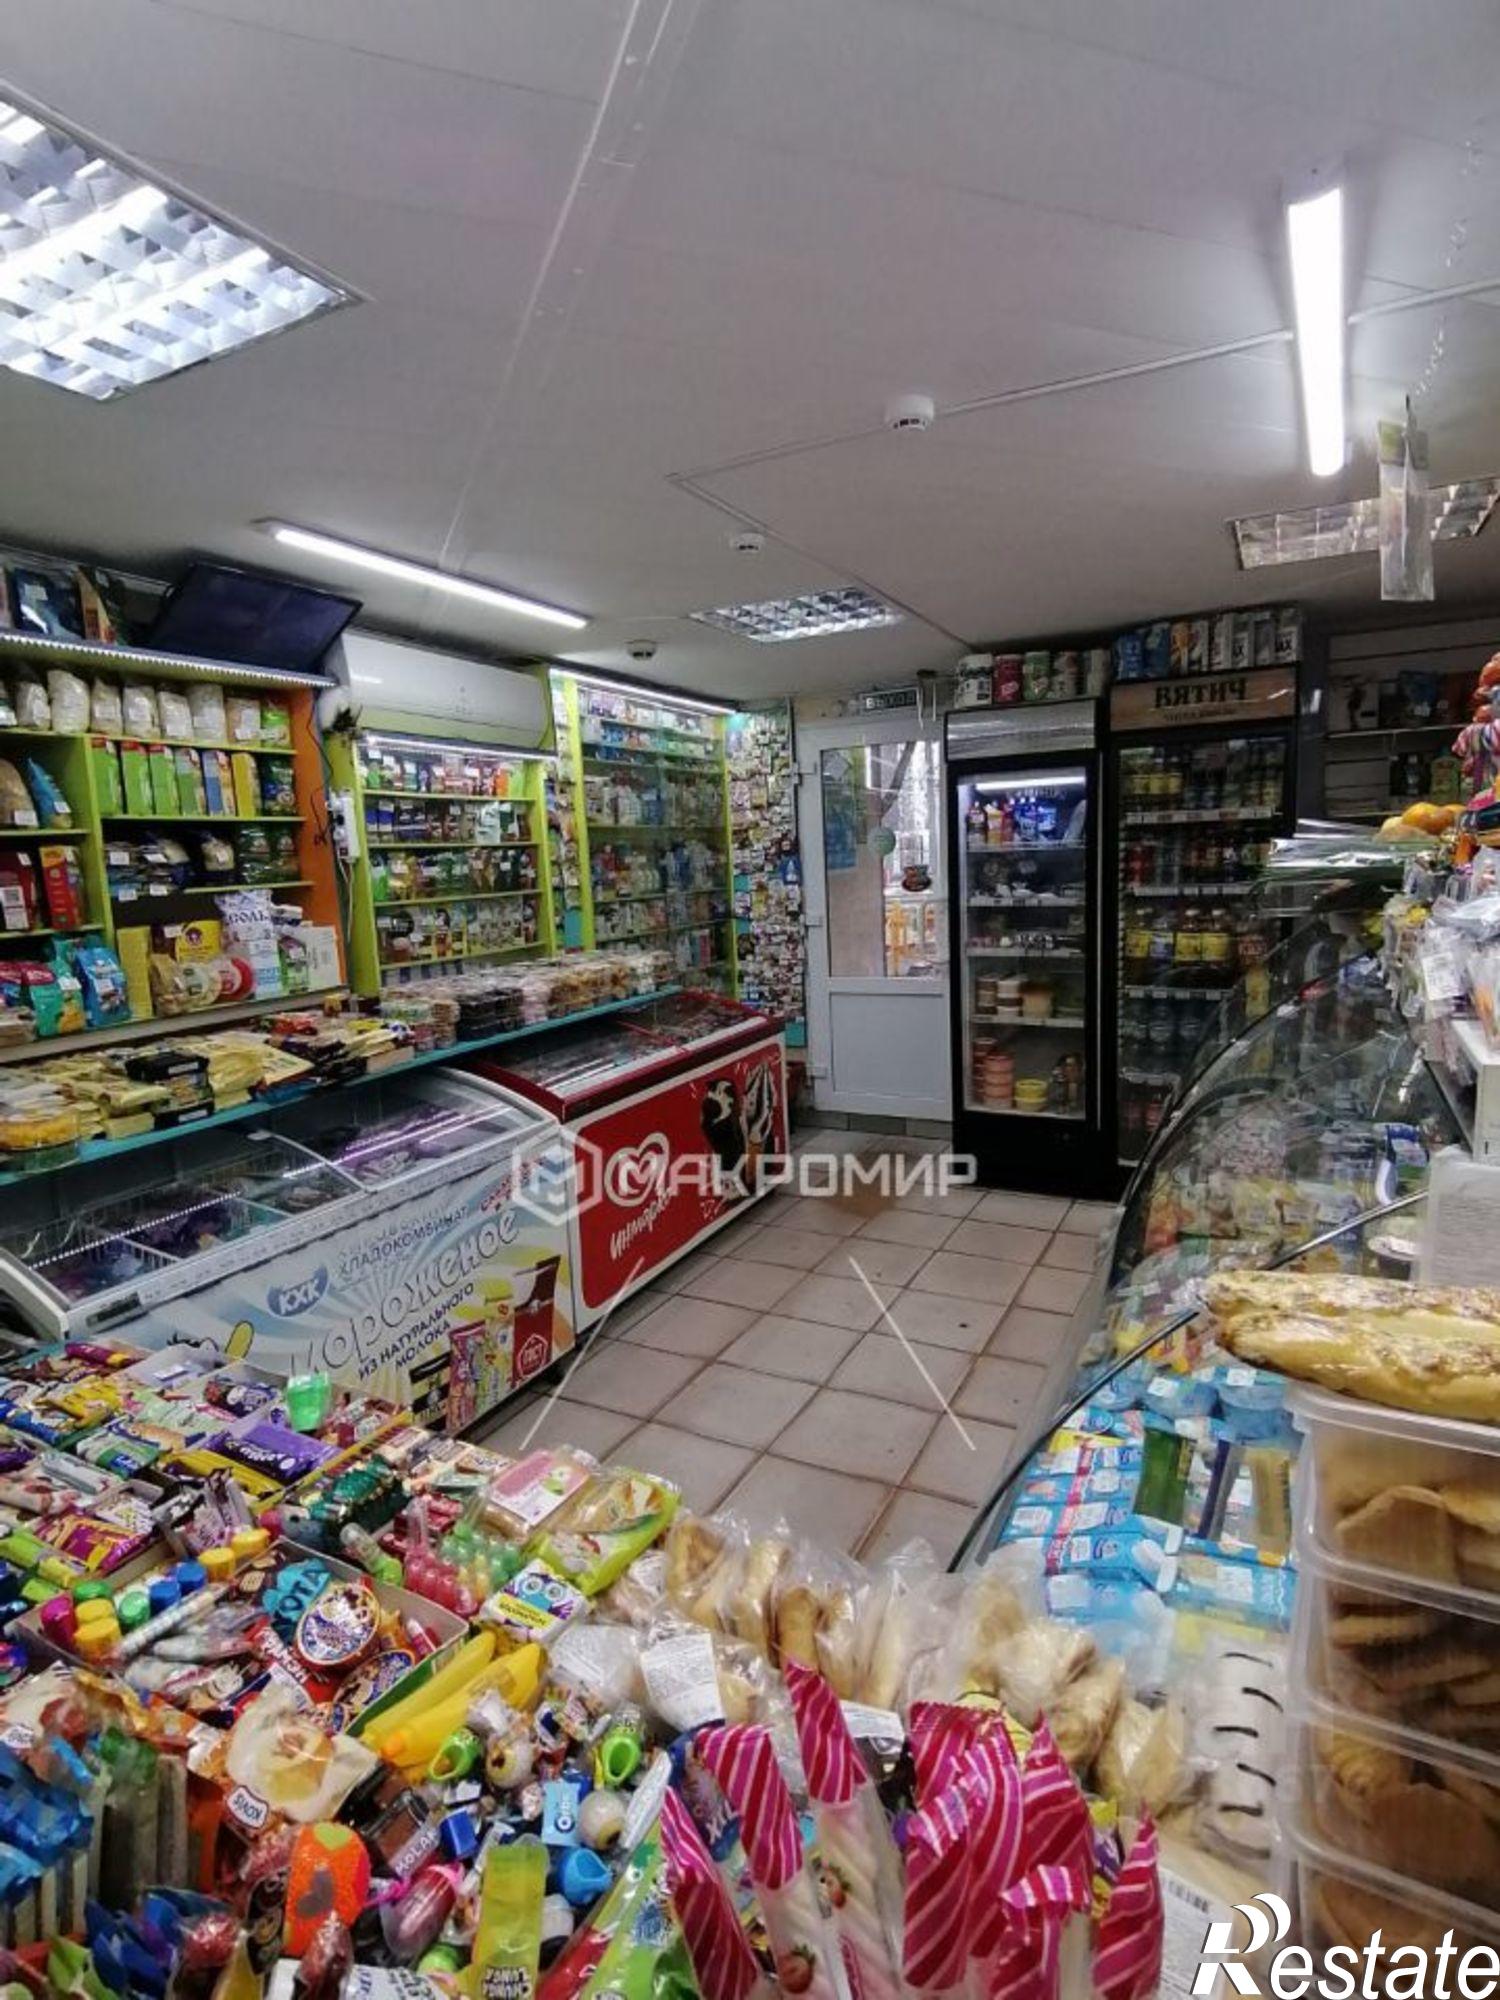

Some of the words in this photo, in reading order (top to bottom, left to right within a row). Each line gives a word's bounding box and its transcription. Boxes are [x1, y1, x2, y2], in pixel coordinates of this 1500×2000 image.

[1155, 678, 1246, 708] ВЯТИЧ
[340, 1205, 467, 1275] ХЛАДОКОМБИНАТ
[358, 1359, 378, 1380] ИЗ
[380, 1281, 474, 1363] НАТУРАЛЬНОГО
[395, 1320, 451, 1370] МОЛОКА
